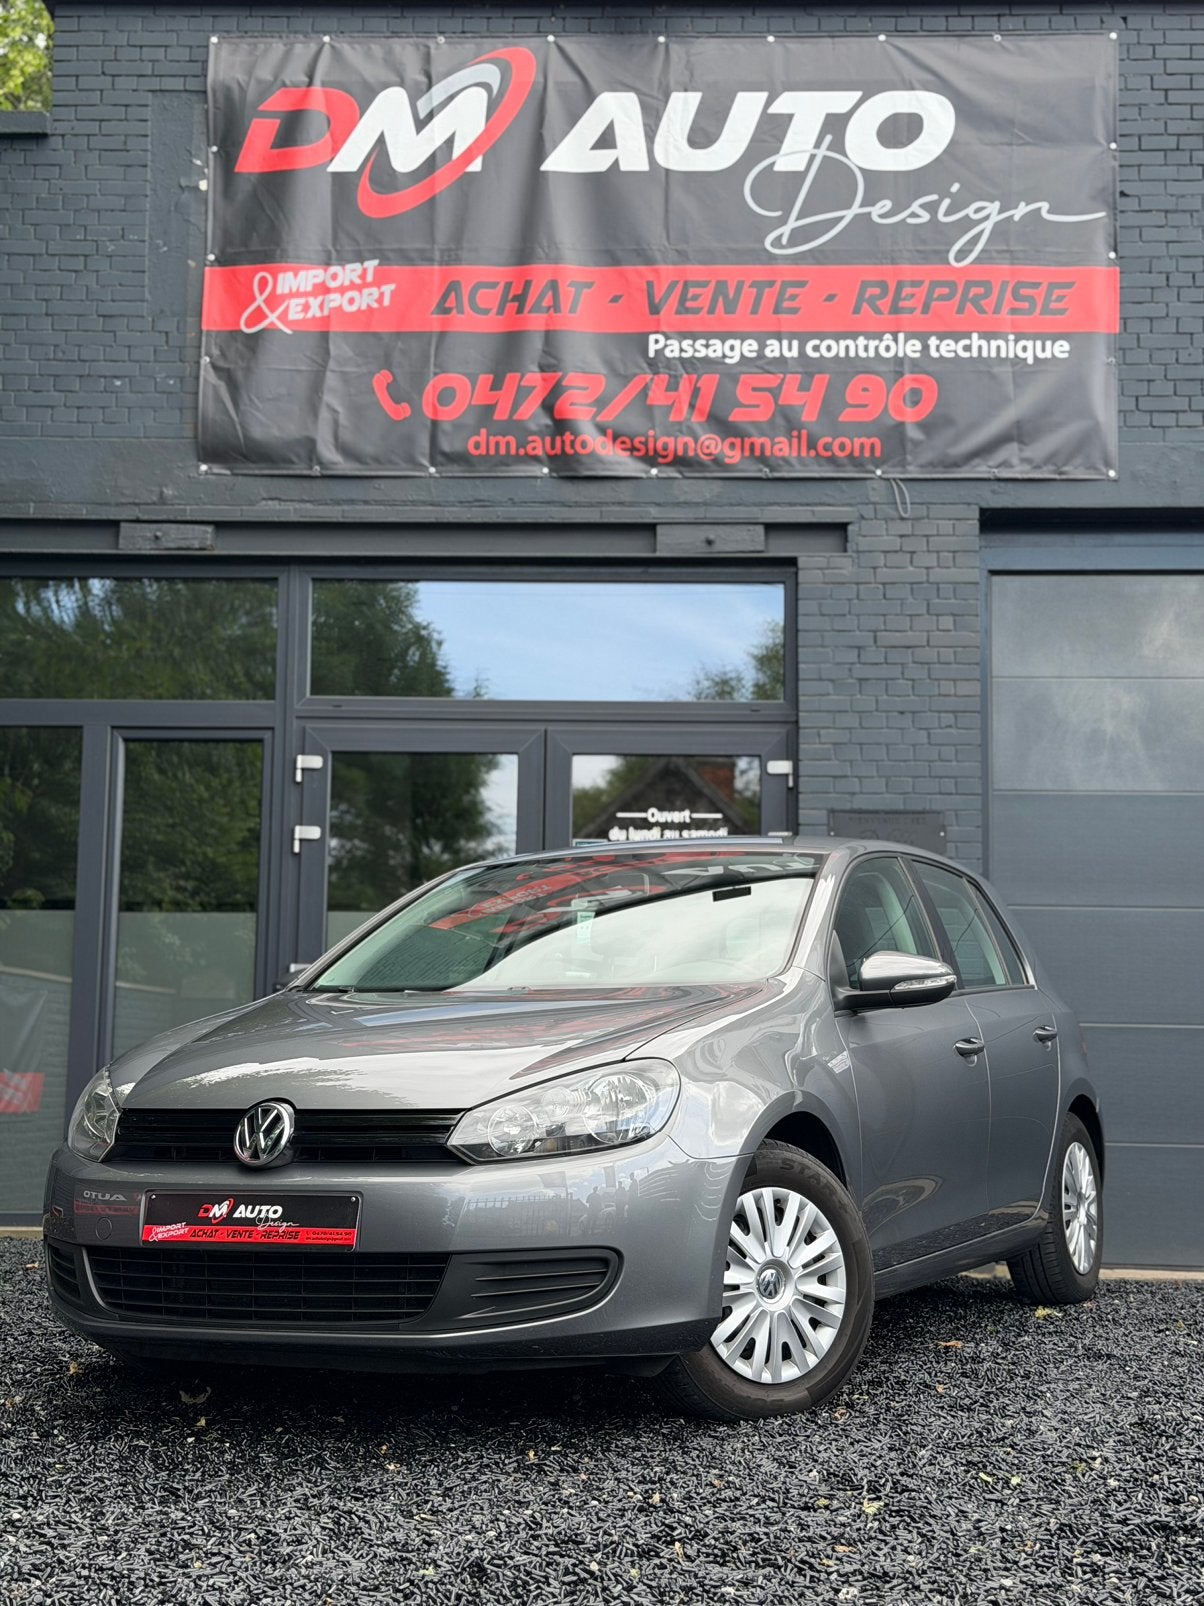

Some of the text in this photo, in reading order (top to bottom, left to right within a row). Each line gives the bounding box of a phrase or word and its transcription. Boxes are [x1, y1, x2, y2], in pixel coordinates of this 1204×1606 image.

[234, 86, 955, 173] DM AUTO
[743, 134, 1107, 266] Design
[275, 259, 379, 295] IMPORT
[287, 283, 395, 321] EXPORT
[430, 280, 596, 316] ACHAT
[645, 279, 809, 317] VENTE
[851, 280, 1077, 317] REPRISE
[648, 332, 1070, 364] Passage au contrôle technique
[422, 372, 938, 422] 0472/41 54 90
[468, 430, 882, 463] dm.autodesign@gmail.com
[647, 807, 690, 823] Ouvert
[198, 1203, 283, 1218] DM AUTO
[190, 1229, 219, 1238] ACHAT
[226, 1230, 254, 1239] VENTE
[260, 1230, 300, 1240] REPRISE
